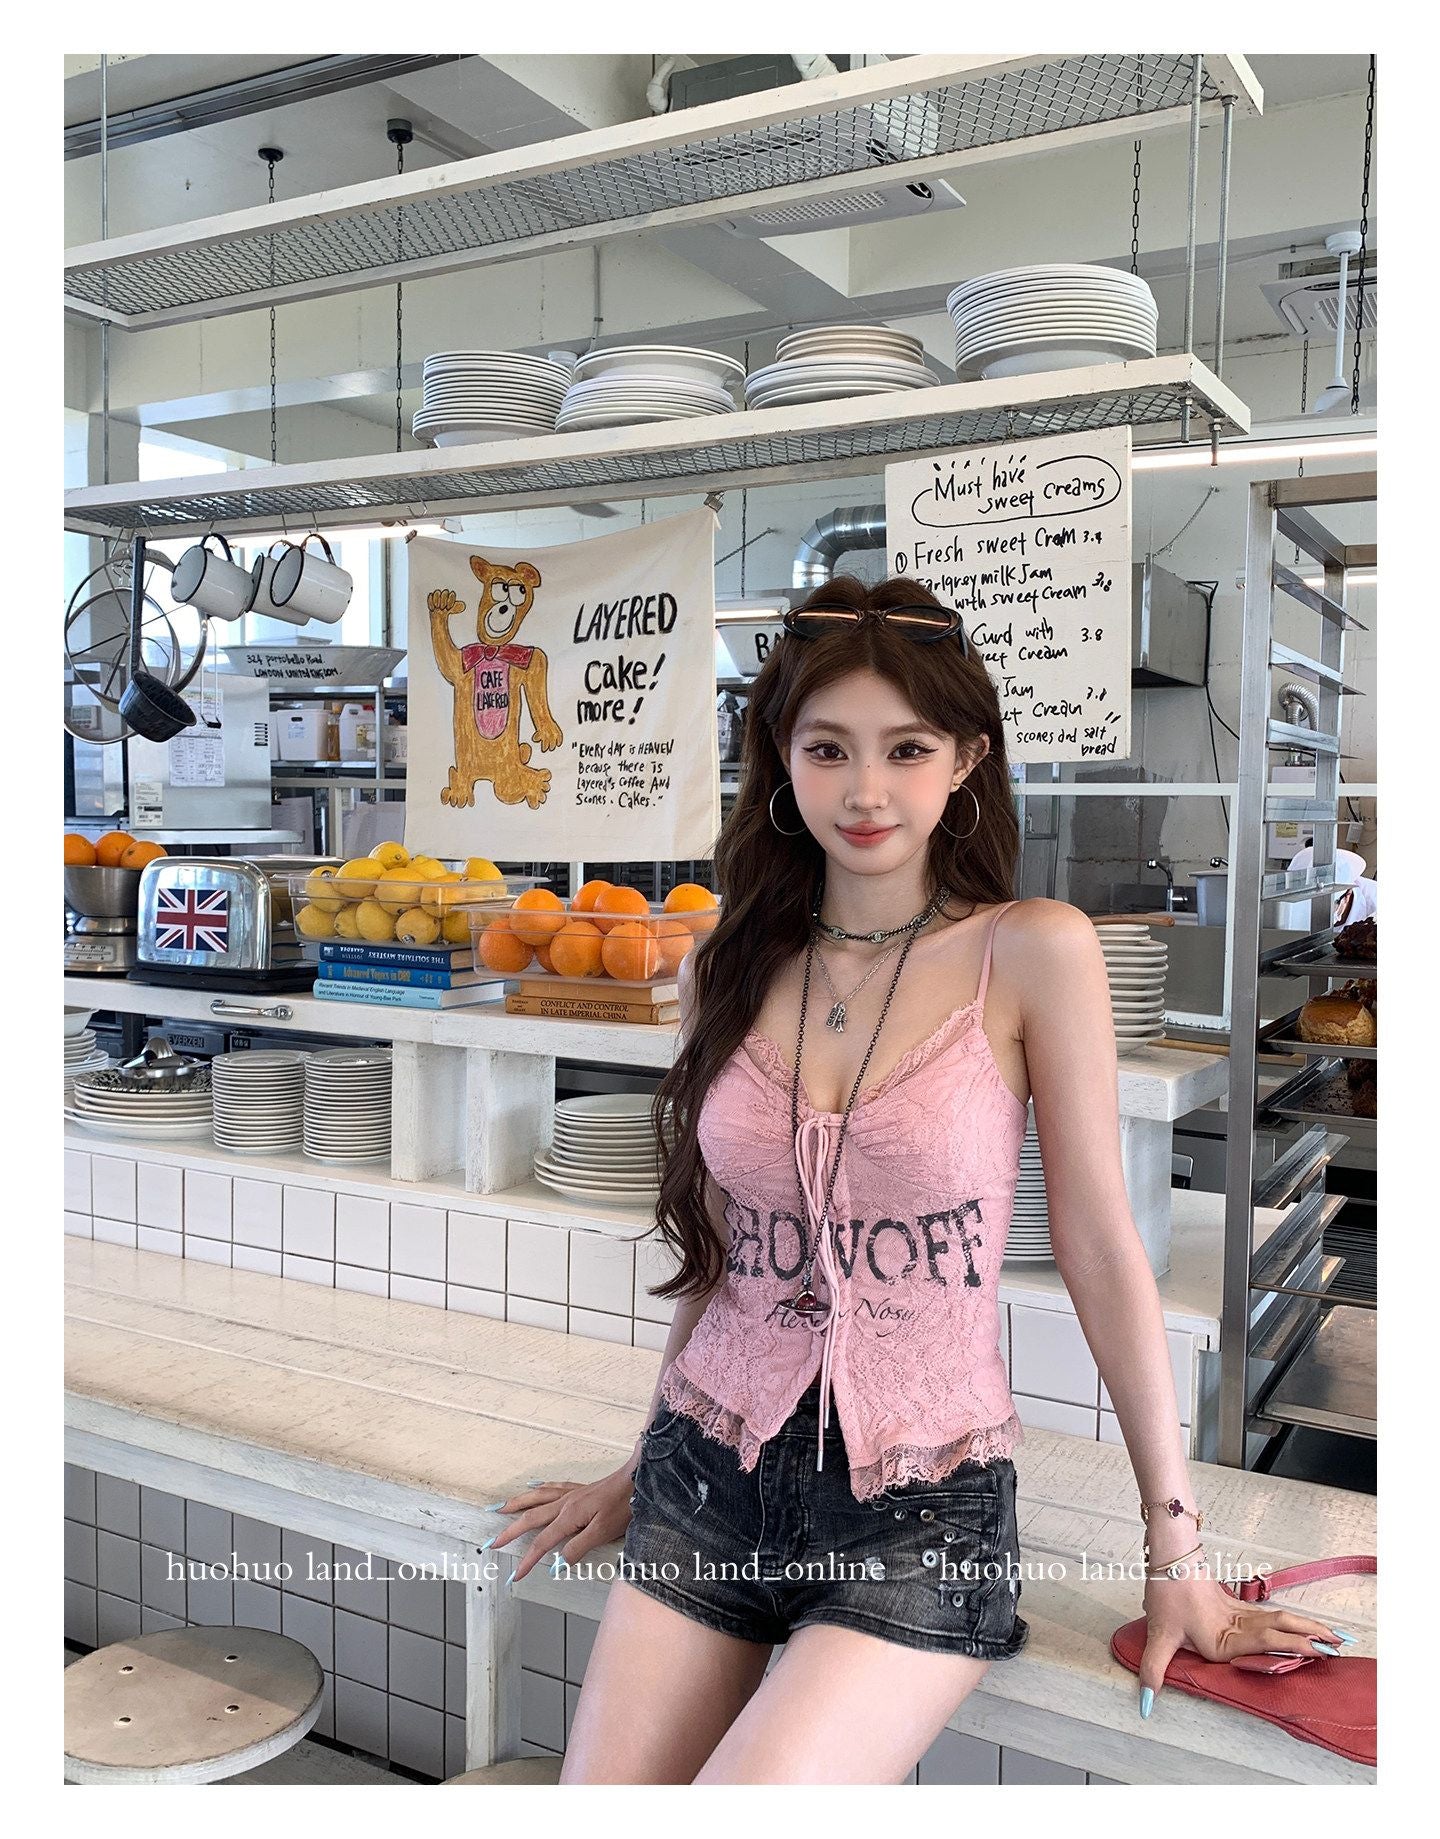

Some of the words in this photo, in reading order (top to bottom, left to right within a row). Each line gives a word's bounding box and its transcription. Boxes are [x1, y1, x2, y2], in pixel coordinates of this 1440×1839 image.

[935, 474, 982, 502] Must
[992, 461, 1026, 490] have
[978, 490, 1034, 516] sweet
[1043, 477, 1105, 500] creams
[914, 535, 963, 569] Fresh
[977, 532, 1026, 555] sweet
[981, 565, 1016, 587] milk
[1018, 563, 1052, 584] Jam
[954, 589, 987, 611] with
[990, 589, 1040, 613] sweet
[573, 592, 677, 644] LAYERED
[971, 623, 1012, 646] Curd
[1025, 617, 1054, 640] with
[1080, 628, 1103, 643] 3.8
[481, 671, 503, 689] CAFE
[584, 653, 666, 695] Cake!
[1002, 675, 1034, 699] Jam
[577, 697, 644, 725] more!
[1016, 731, 1054, 745] scones
[1057, 728, 1078, 743] and
[1083, 726, 1106, 740] salt
[1081, 736, 1117, 756] bread
[629, 744, 636, 755] is
[617, 760, 645, 772] there
[650, 761, 664, 774] is
[397, 953, 430, 963] SOLITAIRE
[431, 956, 444, 964] THE
[540, 1000, 575, 1010] CONFLICT
[577, 1001, 593, 1010] AND
[594, 1002, 629, 1012] CONTROL
[568, 1009, 602, 1019] IMPERIAL
[602, 1011, 627, 1020] CHINA
